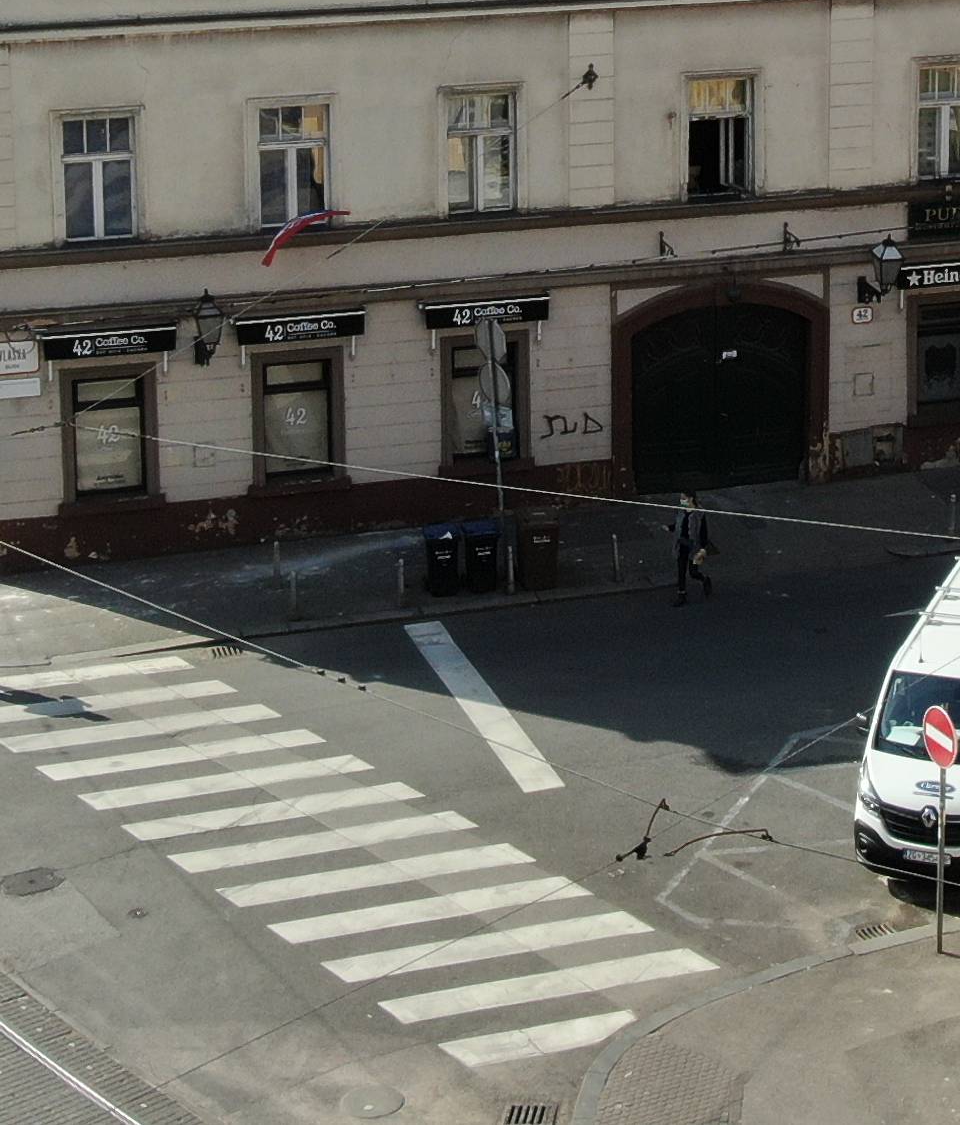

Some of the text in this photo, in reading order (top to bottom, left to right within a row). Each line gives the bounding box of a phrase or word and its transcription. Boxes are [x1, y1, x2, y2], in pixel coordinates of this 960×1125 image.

[453, 308, 471, 326] 42
[474, 306, 505, 317] Coffee
[265, 324, 284, 343] 42
[286, 321, 319, 333] Coffee
[73, 339, 93, 356] 42
[95, 336, 129, 348] Coffee
[285, 407, 308, 426] 42
